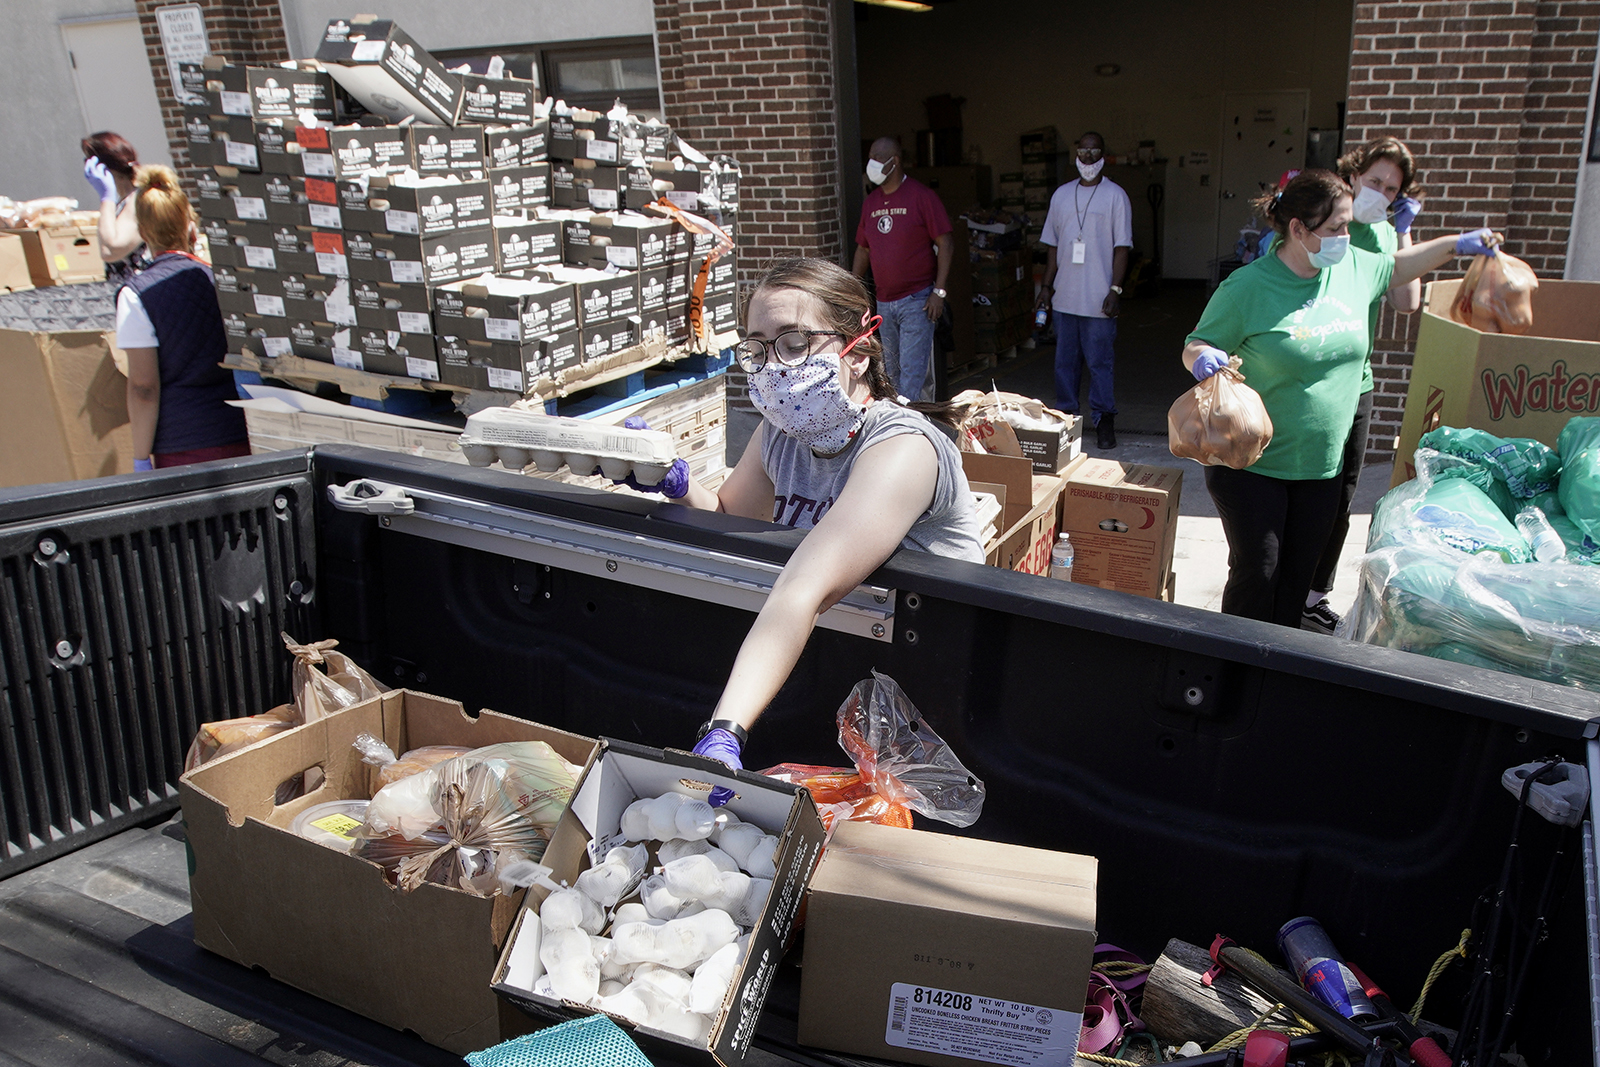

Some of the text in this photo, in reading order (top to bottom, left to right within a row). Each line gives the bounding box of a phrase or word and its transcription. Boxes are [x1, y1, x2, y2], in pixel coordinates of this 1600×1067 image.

[1120, 494, 1160, 507] REFRIGERATED
[804, 842, 820, 881] GARLIC
[731, 1006, 749, 1051] SPICE
[748, 948, 770, 1002] WORLD
[914, 988, 972, 1011] 814208
[912, 1007, 936, 1015] UNCOOKED
[937, 1011, 960, 1020] BONELESS
[961, 1014, 980, 1022] CHICKEN
[1000, 1021, 1019, 1030] FRITTER
[981, 1007, 1020, 1020] Thrifty Buy
